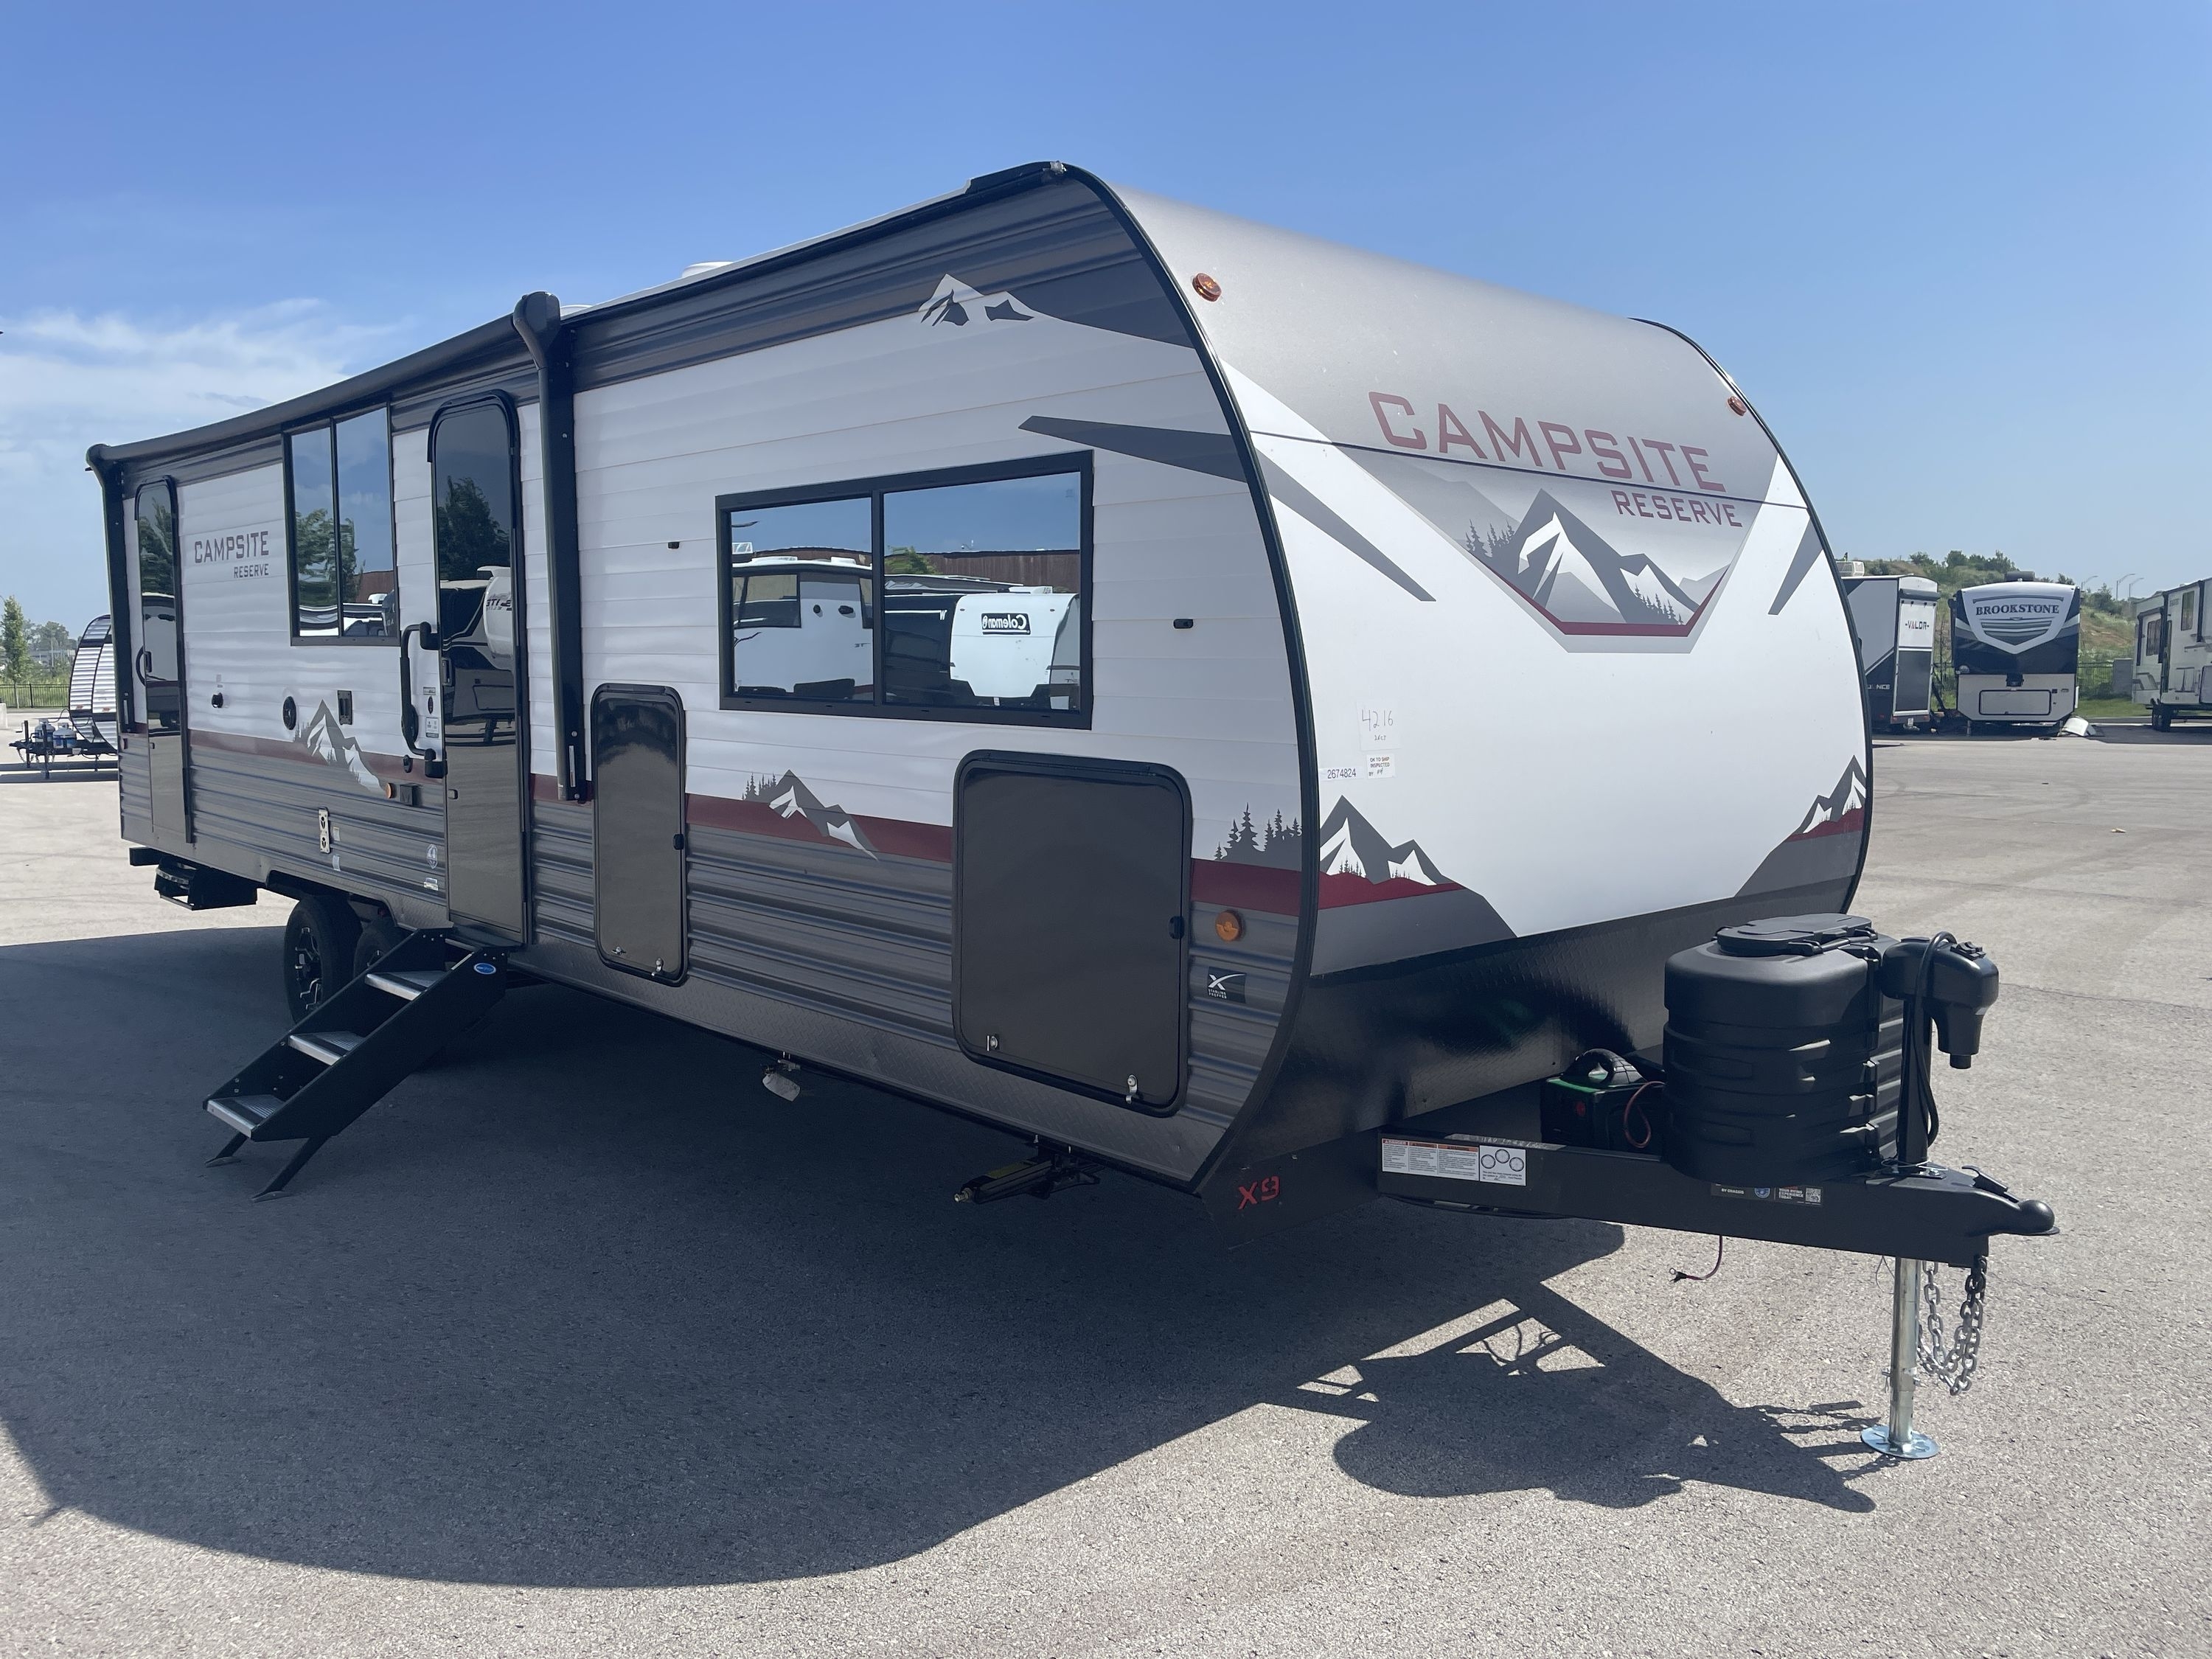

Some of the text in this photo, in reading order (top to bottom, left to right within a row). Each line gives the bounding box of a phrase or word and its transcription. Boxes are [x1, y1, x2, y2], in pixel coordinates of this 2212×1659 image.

[1368, 391, 1726, 493] CAMPSITE
[1610, 490, 1742, 527] RESERVE
[195, 531, 269, 563] CAMPSITE
[233, 564, 269, 578] RESERVE
[1975, 604, 2060, 616] BROOKSTONE
[1361, 709, 1394, 731] 4216
[1327, 768, 1357, 779] 2674824
